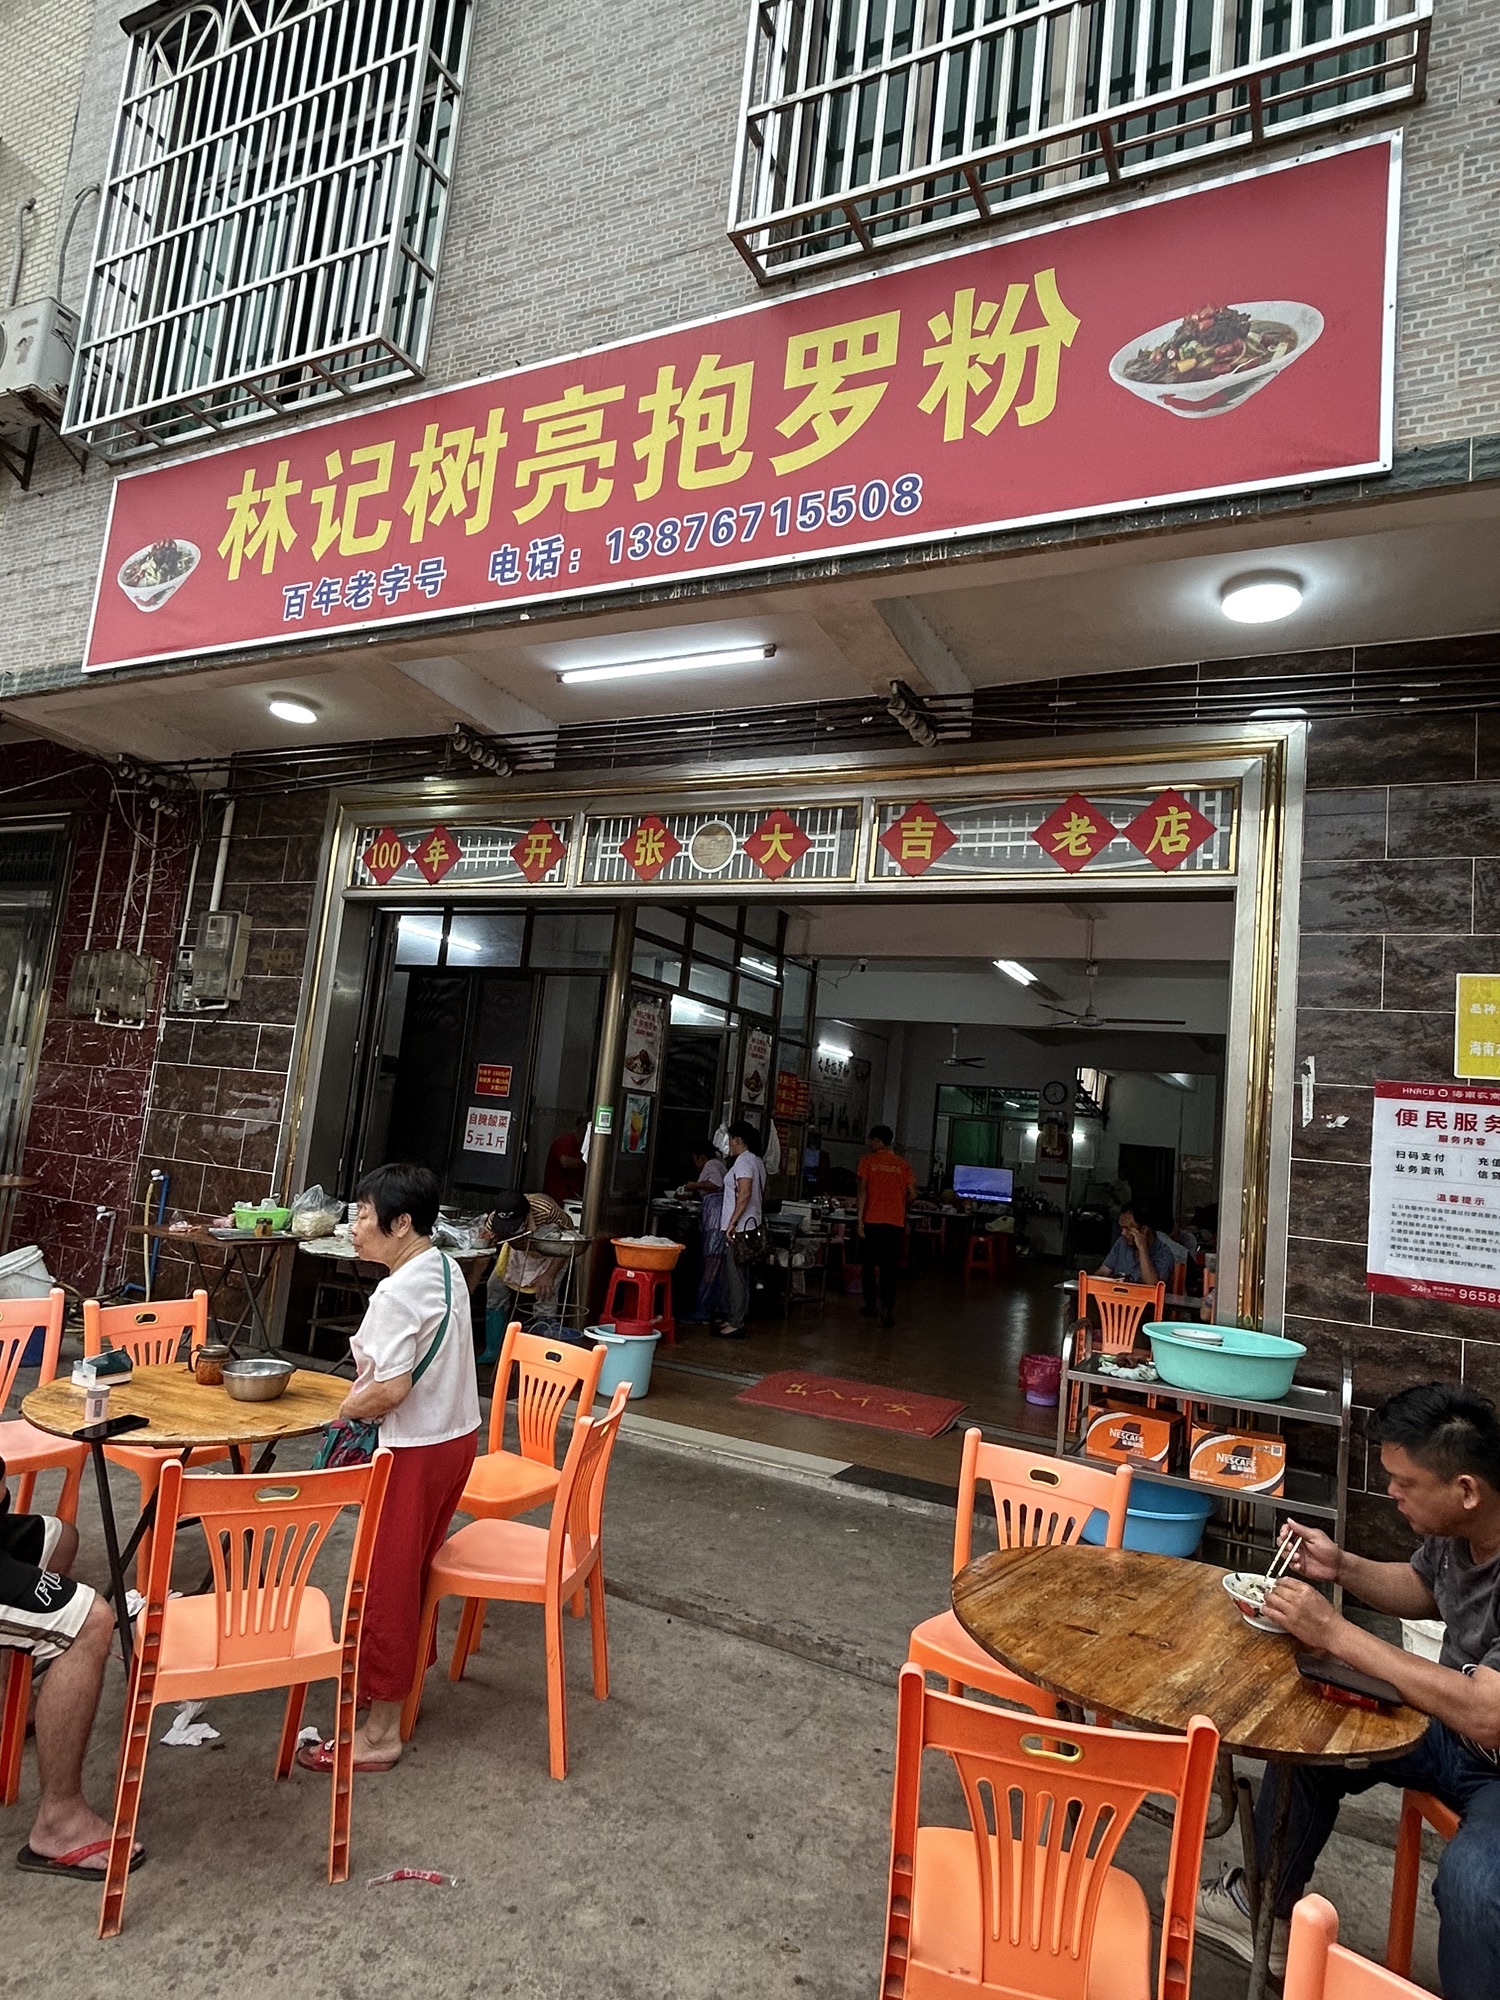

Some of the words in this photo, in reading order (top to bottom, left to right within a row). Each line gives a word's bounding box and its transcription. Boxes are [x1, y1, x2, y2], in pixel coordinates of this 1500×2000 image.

[217, 268, 1081, 580] 林记树亮抱罗粉
[282, 557, 447, 621] 百年老字号
[606, 472, 923, 564] 13876715508
[370, 842, 401, 870] 100
[1402, 1087, 1435, 1096] HNRCB
[1395, 1108, 1500, 1134] 便民服务
[466, 1130, 505, 1149] 5元1斤
[1438, 1134, 1486, 1146] 服务内容
[1396, 1150, 1445, 1163] 扫码支付
[1395, 1163, 1445, 1176] 业务资讯
[1436, 1193, 1486, 1206] 温馨提示
[1458, 1289, 1500, 1306] 9658
